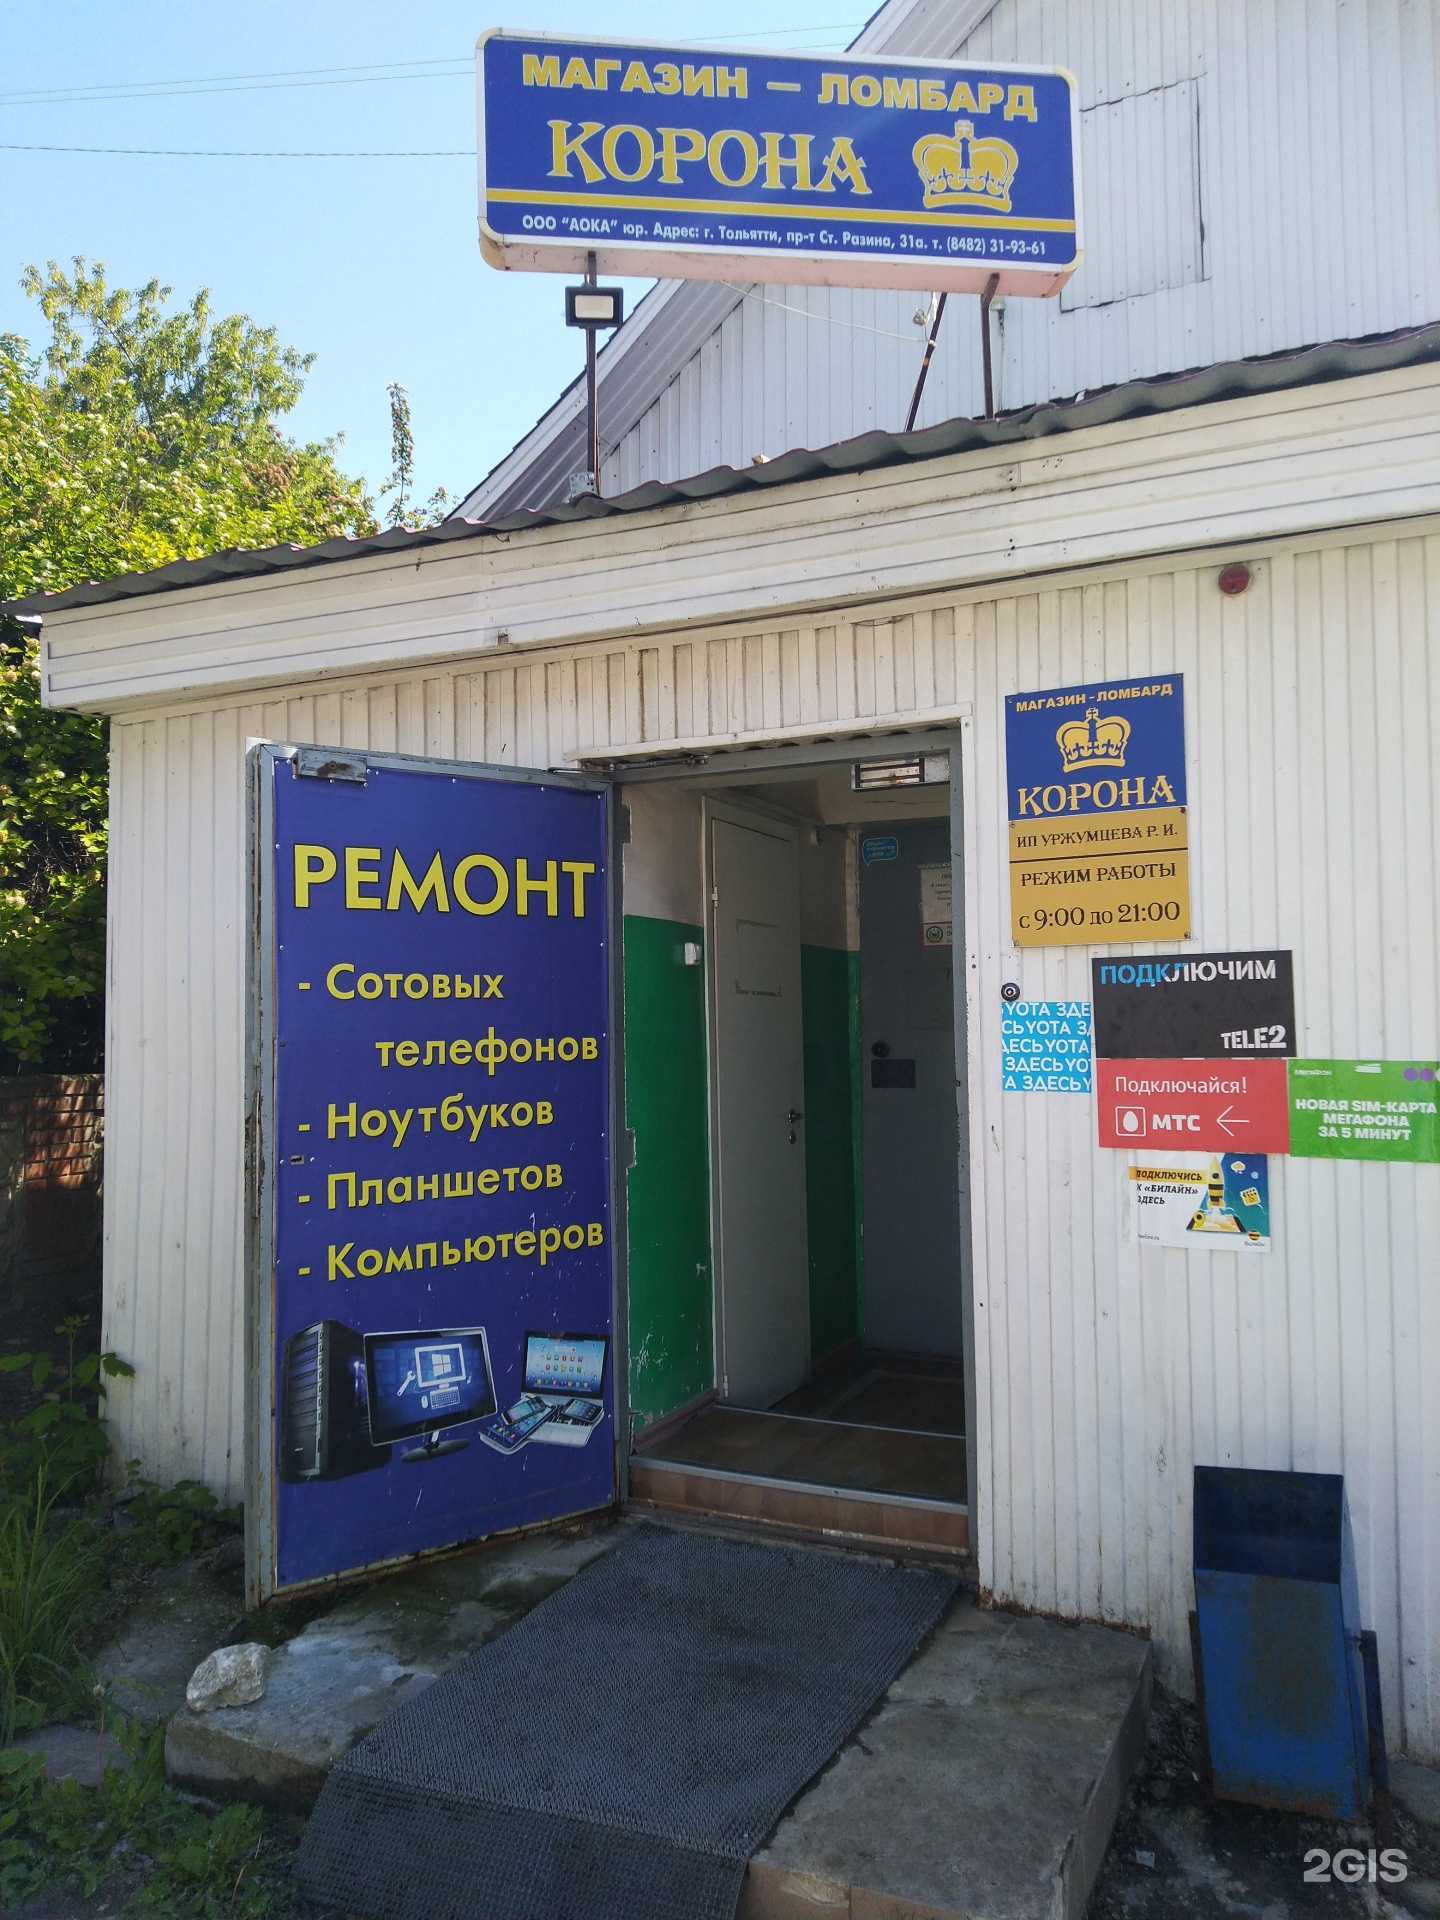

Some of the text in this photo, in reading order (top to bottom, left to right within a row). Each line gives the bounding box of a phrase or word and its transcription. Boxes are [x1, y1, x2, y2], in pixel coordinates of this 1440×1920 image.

[522, 54, 748, 99] МАГАЗИН
[818, 72, 1038, 123] ЛОМБАРД
[546, 120, 873, 194] КОРОНА
[522, 215, 557, 230] ООО
[623, 223, 648, 238] юр.
[653, 222, 699, 240] Адрес:
[704, 228, 714, 240] г.
[718, 226, 781, 245] Тольятти,
[786, 231, 815, 246] пр-т
[819, 230, 838, 244] Ст.
[842, 231, 896, 250] Разина,
[900, 234, 928, 249] 31а.
[932, 238, 942, 250] т.
[947, 236, 986, 255] (8482)
[990, 239, 1046, 255] 31-93-61
[1016, 694, 1086, 712] МАГАЗИН
[1096, 683, 1173, 702] ЛОМБАРД
[1018, 775, 1177, 816] КОРОНА
[1017, 824, 1178, 848] ИП УРЖУМЦЕВА Р. И.
[294, 844, 596, 918] РЕМОНТ
[1021, 862, 1177, 887] РЕЖИМ РАБОТЫ
[1034, 906, 1085, 931] 9:00
[1090, 910, 1113, 925] до
[1118, 901, 1181, 923] 21:00
[326, 963, 504, 1000] Сотовых
[1100, 960, 1276, 987] ПОДКЛЮЧИМ
[1025, 1020, 1071, 1035] YOTA
[1220, 1025, 1287, 1049] TELE2
[375, 1026, 599, 1076] телефонов
[1044, 1039, 1089, 1054] YOTA
[1005, 1057, 1091, 1073] ЗДЕСЬ YO
[1022, 1075, 1081, 1092] ЗДЕСЬ
[1115, 1076, 1248, 1095] Подключайся!
[1295, 1099, 1437, 1114] НОВАЯ SIM-КАРТА
[327, 1092, 554, 1148] Ноутбуков
[1152, 1114, 1200, 1132] МТС
[1323, 1113, 1410, 1127] МЕГАФОНА
[1318, 1126, 1411, 1141] ЗА 5 МИНУТ
[327, 1163, 563, 1210] Планшетов
[1136, 1170, 1202, 1181] ПОДКЛЮЧИСЬ
[1137, 1195, 1165, 1205] ЗДЕСЬ
[1144, 1184, 1199, 1195] «БИЛАЙН»
[327, 1222, 604, 1281] Компьютеров
